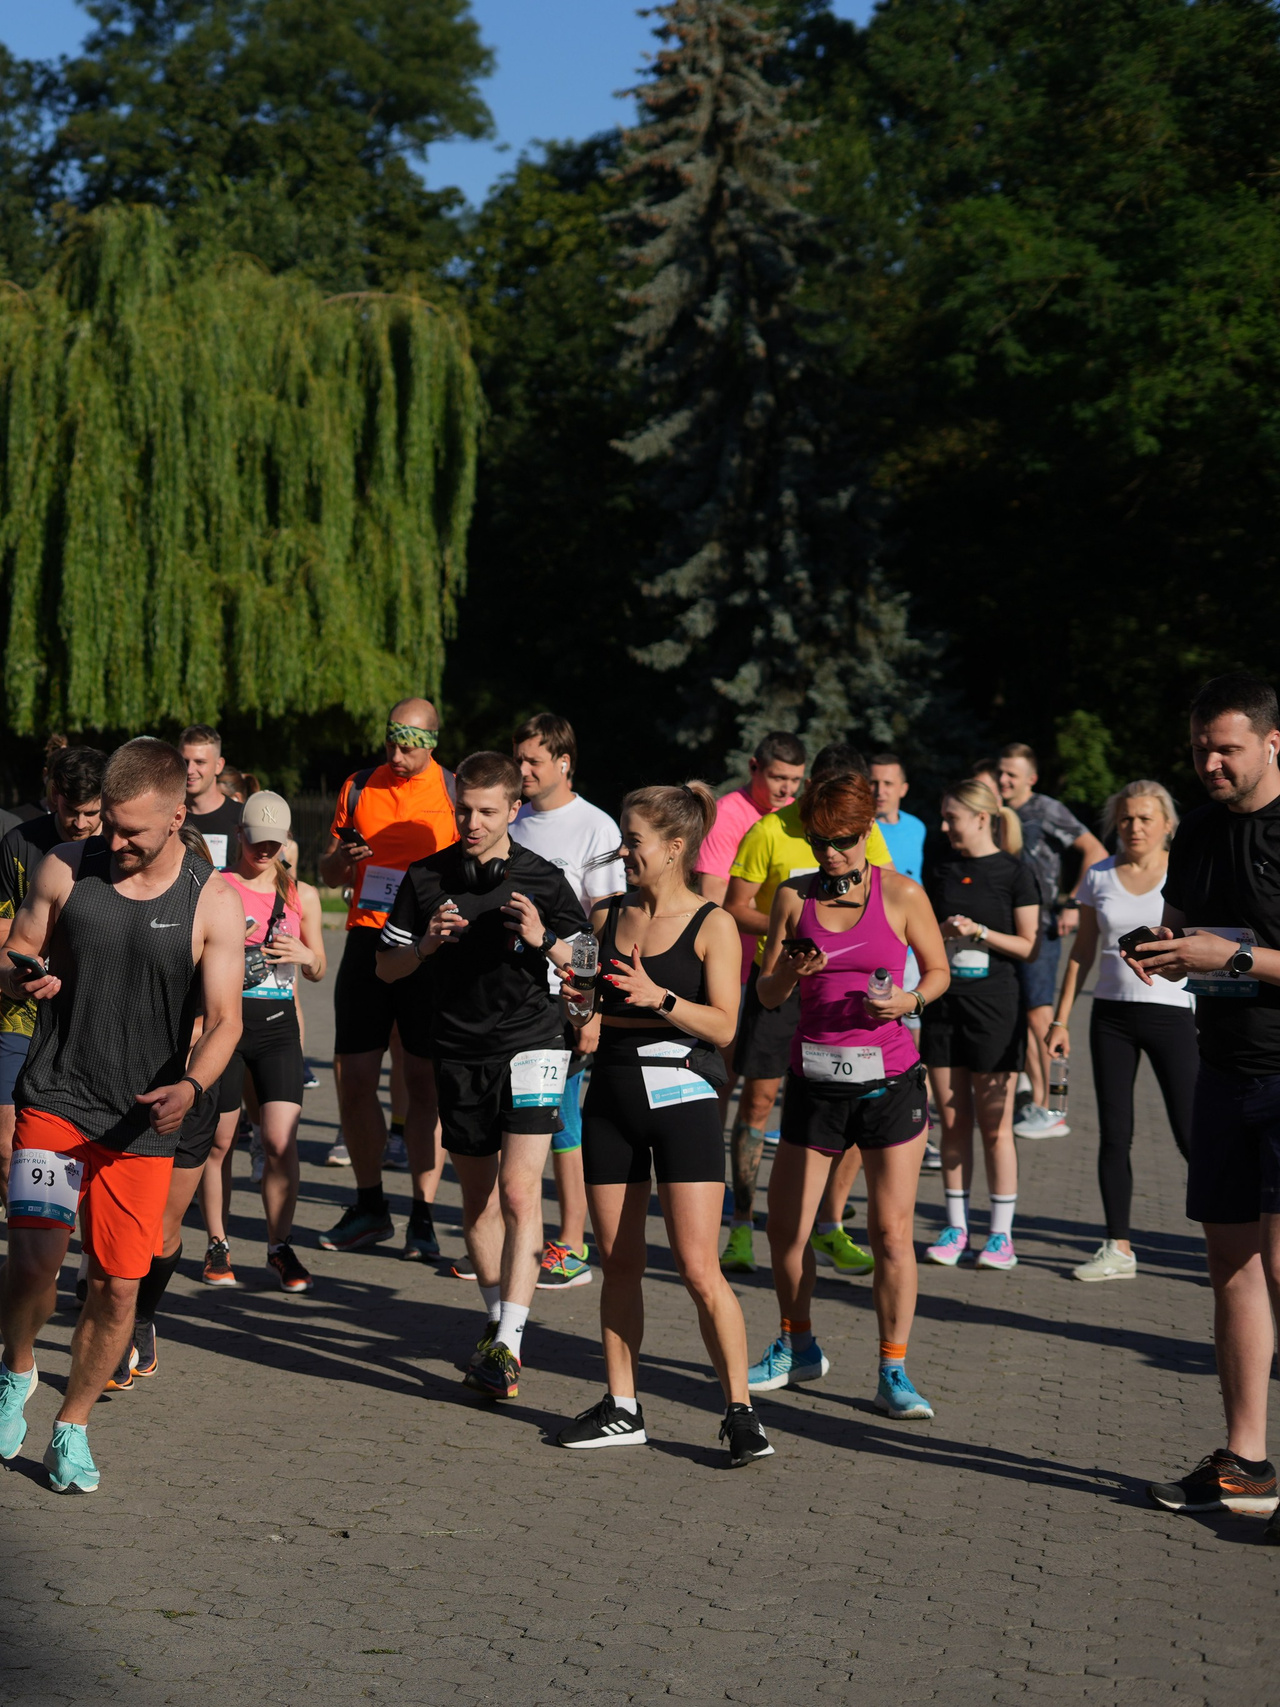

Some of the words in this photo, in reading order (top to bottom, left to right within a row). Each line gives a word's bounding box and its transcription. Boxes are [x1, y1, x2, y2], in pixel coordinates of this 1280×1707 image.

[514, 1059, 537, 1067] CHARITY
[832, 1062, 853, 1076] 70
[540, 1065, 558, 1080] 72
[31, 1168, 55, 1187] 93
